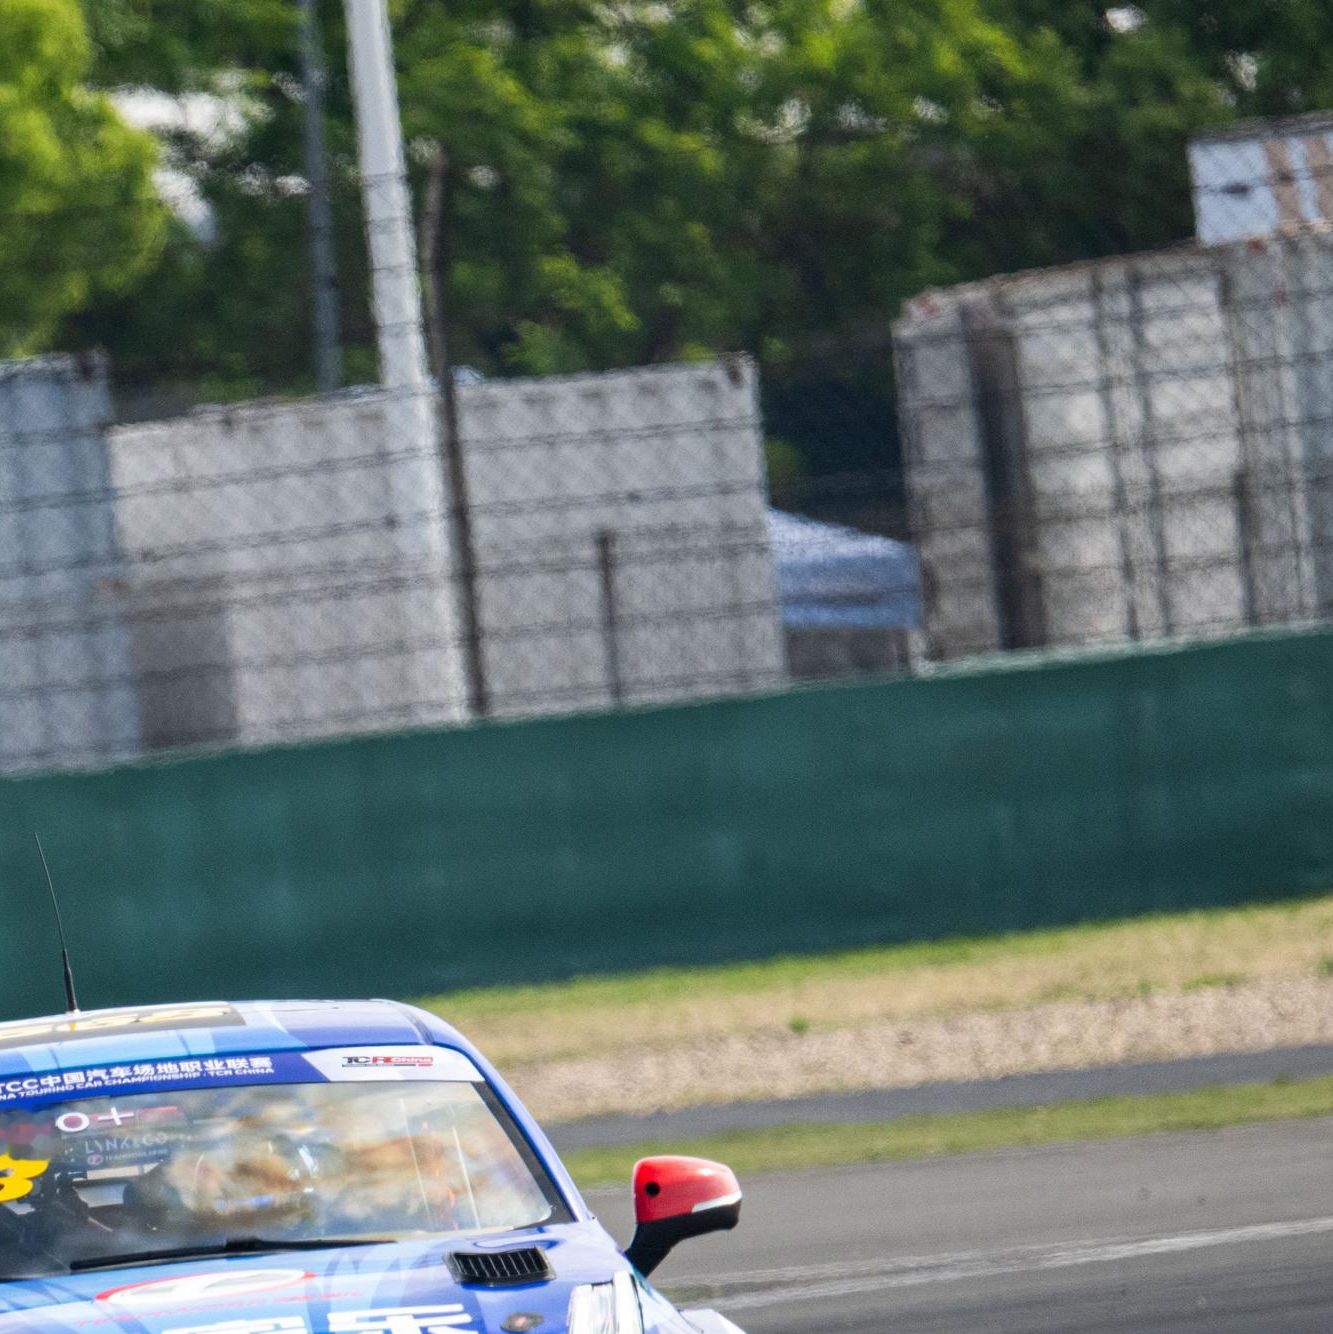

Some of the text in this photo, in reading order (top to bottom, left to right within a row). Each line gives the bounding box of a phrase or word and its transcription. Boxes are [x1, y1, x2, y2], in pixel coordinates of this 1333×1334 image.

[18, 1084, 75, 1097] TOURING
[76, 1079, 103, 1090] CAR
[103, 1071, 201, 1087] CHAMPIONSHIP
[208, 1068, 233, 1077] TCR
[234, 1067, 275, 1076] CHINA
[55, 1107, 135, 1133] O+
